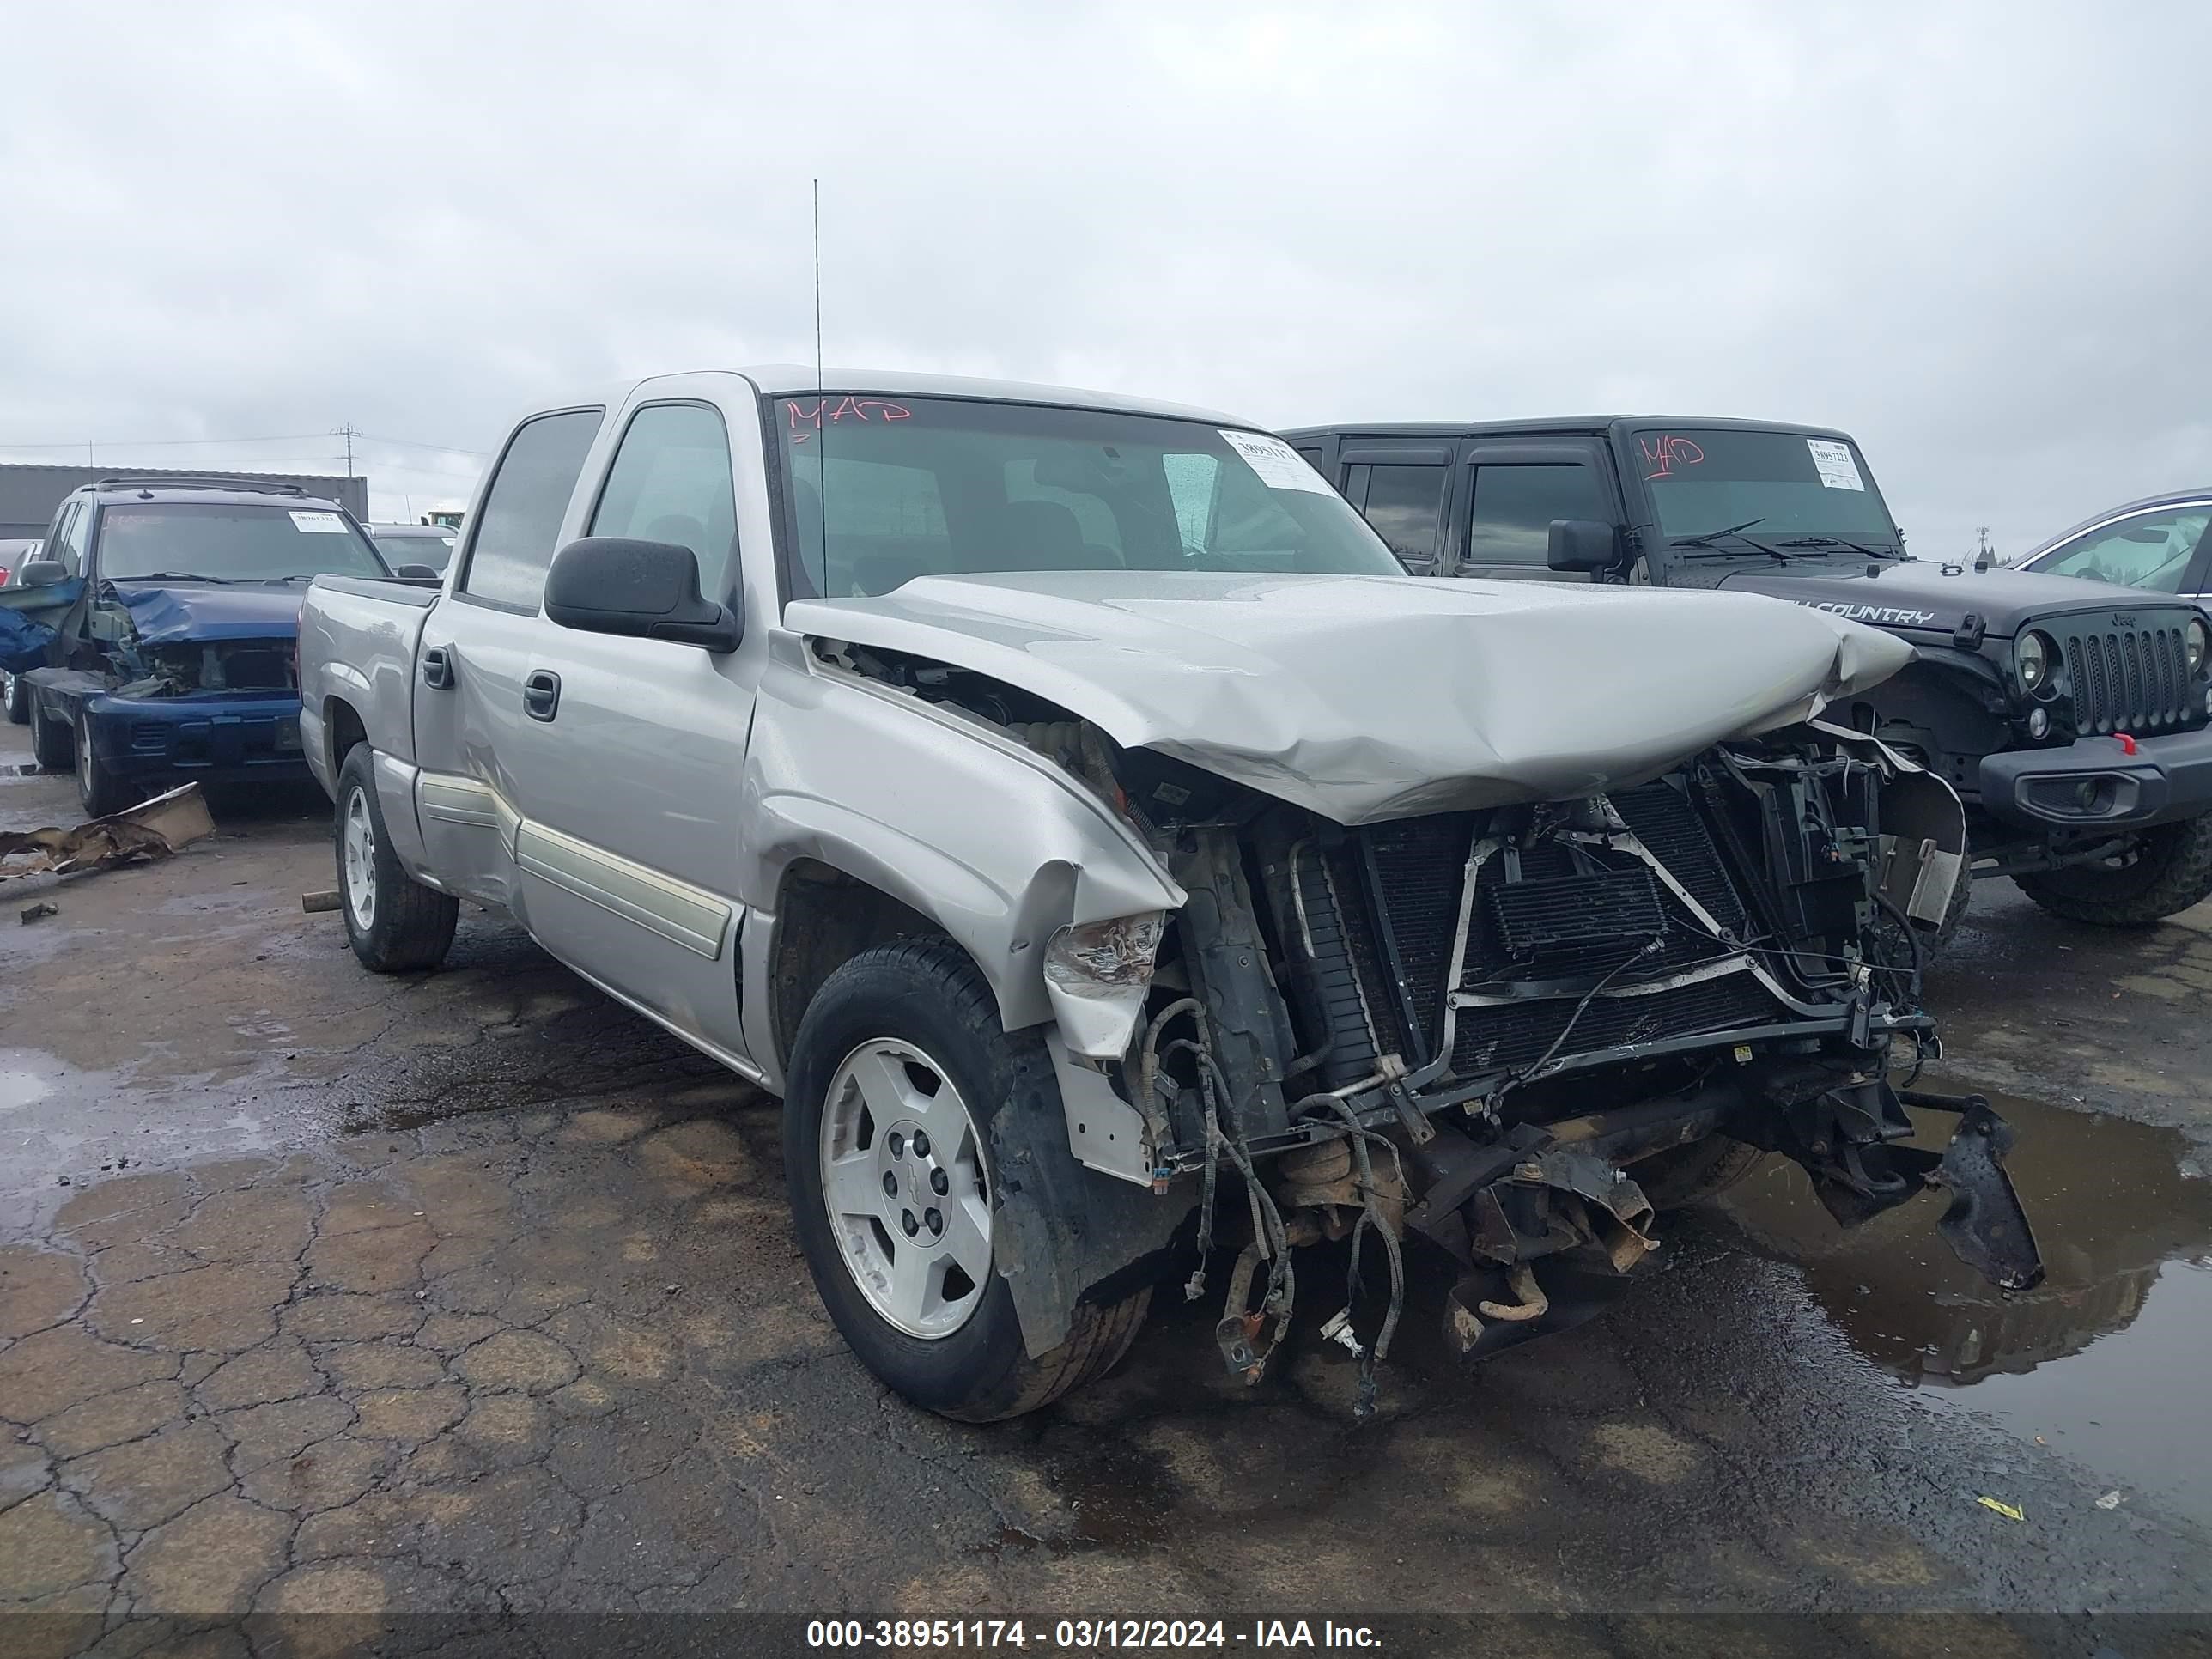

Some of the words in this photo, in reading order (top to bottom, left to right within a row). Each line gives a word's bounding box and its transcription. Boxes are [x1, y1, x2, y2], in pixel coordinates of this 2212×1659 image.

[787, 397, 911, 429] MAD
[1237, 441, 1300, 463] 38951174
[1639, 434, 1705, 472] MAD
